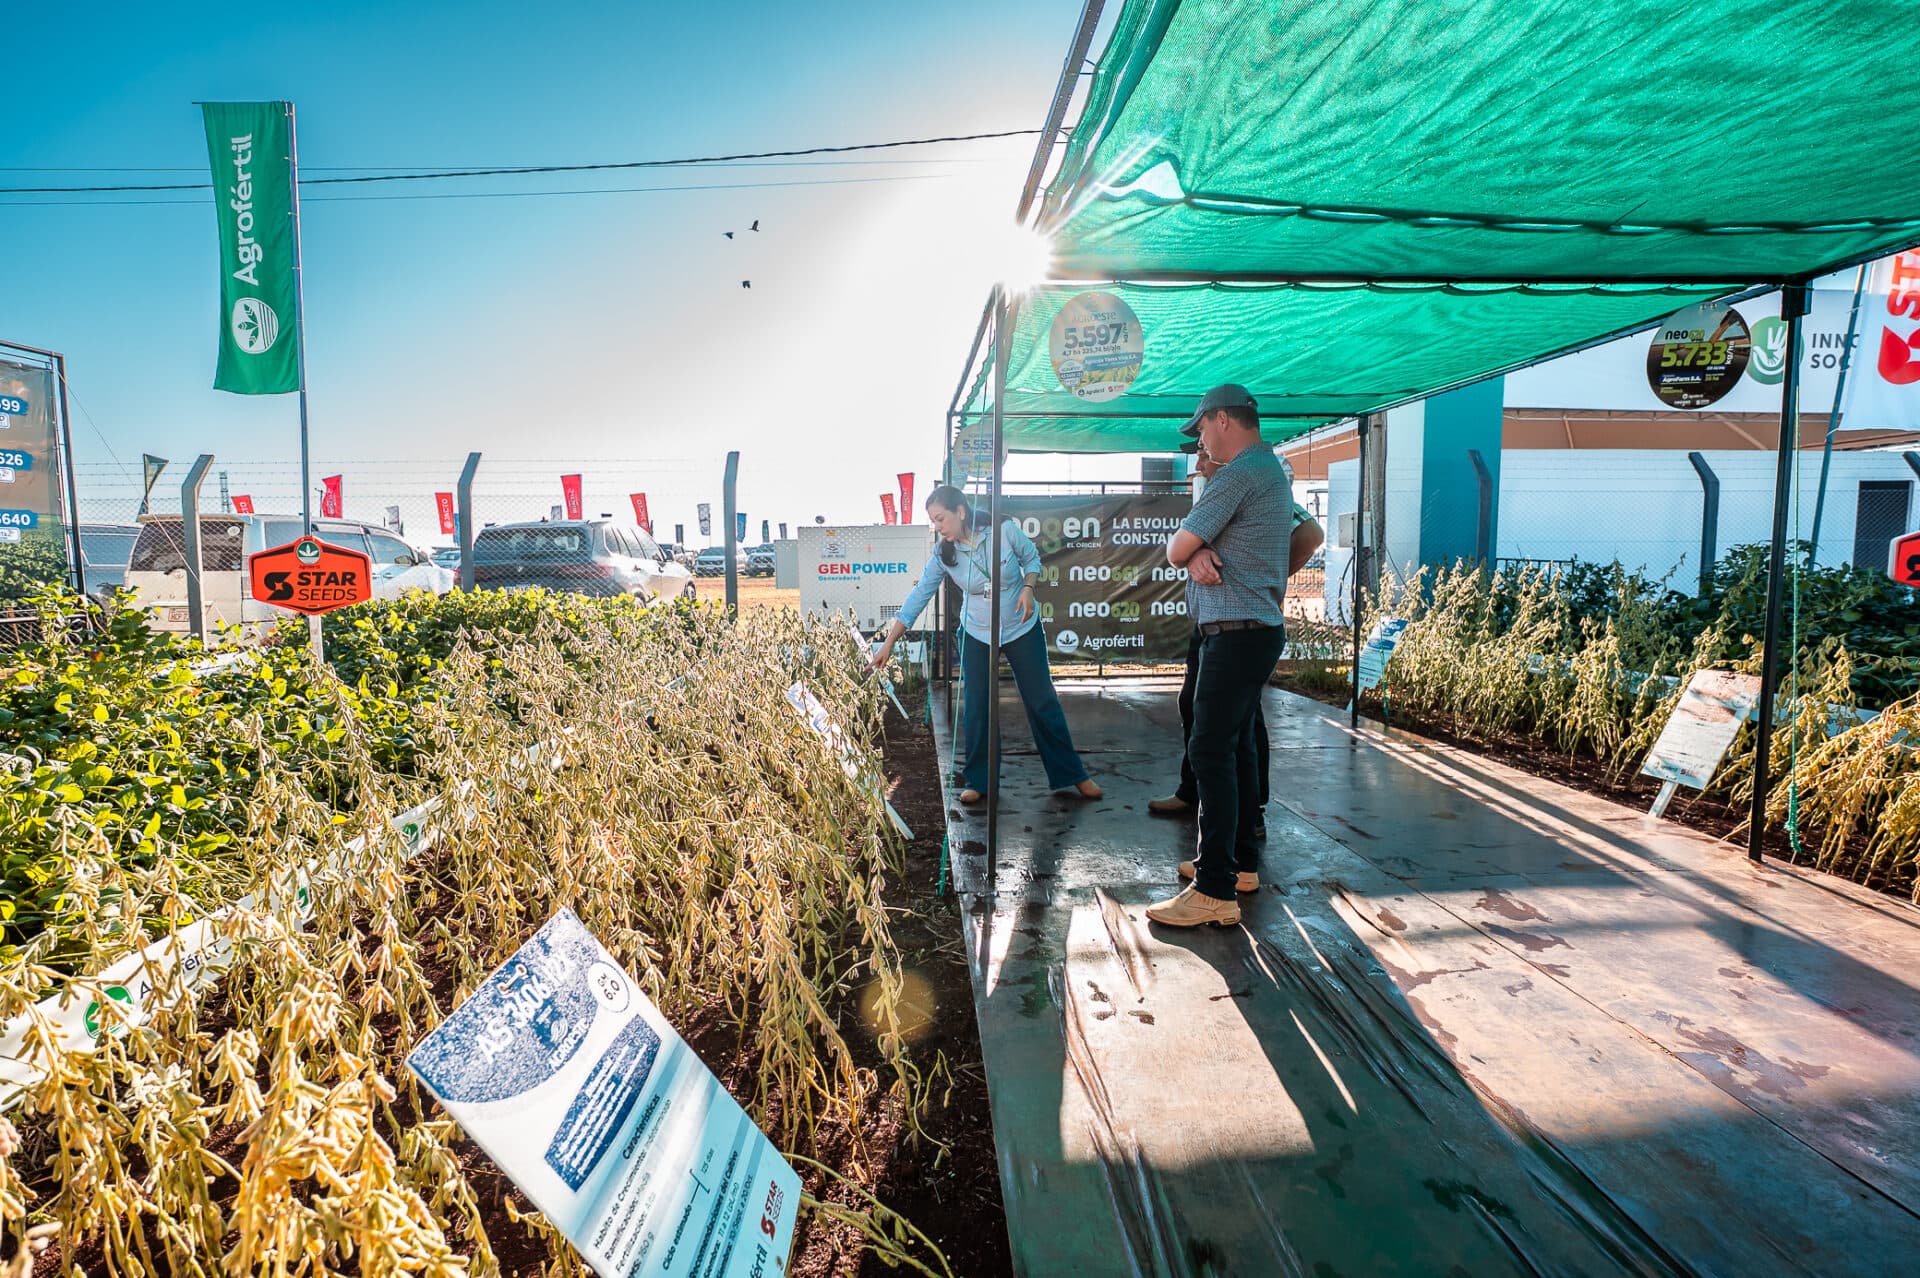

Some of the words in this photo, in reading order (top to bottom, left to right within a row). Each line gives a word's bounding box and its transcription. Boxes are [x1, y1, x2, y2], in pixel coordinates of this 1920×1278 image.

[231, 133, 259, 287] Agrofértil
[1887, 247, 1920, 320] ST
[1064, 323, 1122, 348] 5.597
[1661, 342, 1728, 367] 5.733
[1725, 341, 1735, 365] kg/ha
[0, 399, 20, 412] 99
[0, 514, 30, 526] 640
[1112, 518, 1132, 529] LA
[1012, 517, 1100, 553] ogen
[297, 571, 356, 586] STAR
[1152, 565, 1188, 581] neo
[298, 588, 357, 601] SEEDS
[1069, 601, 1140, 617] neo620
[1150, 601, 1187, 615] neo
[1083, 634, 1144, 650] Agrofértil
[603, 980, 620, 1001] 6.0
[477, 1019, 514, 1065] AS
[720, 1178, 729, 1194] del
[725, 1150, 738, 1179] Cultivo
[612, 1203, 620, 1215] de
[765, 1180, 778, 1216] STAR
[662, 1245, 676, 1270] Ciclo
[674, 1204, 692, 1245] estimado
[750, 1243, 767, 1278] fértil
